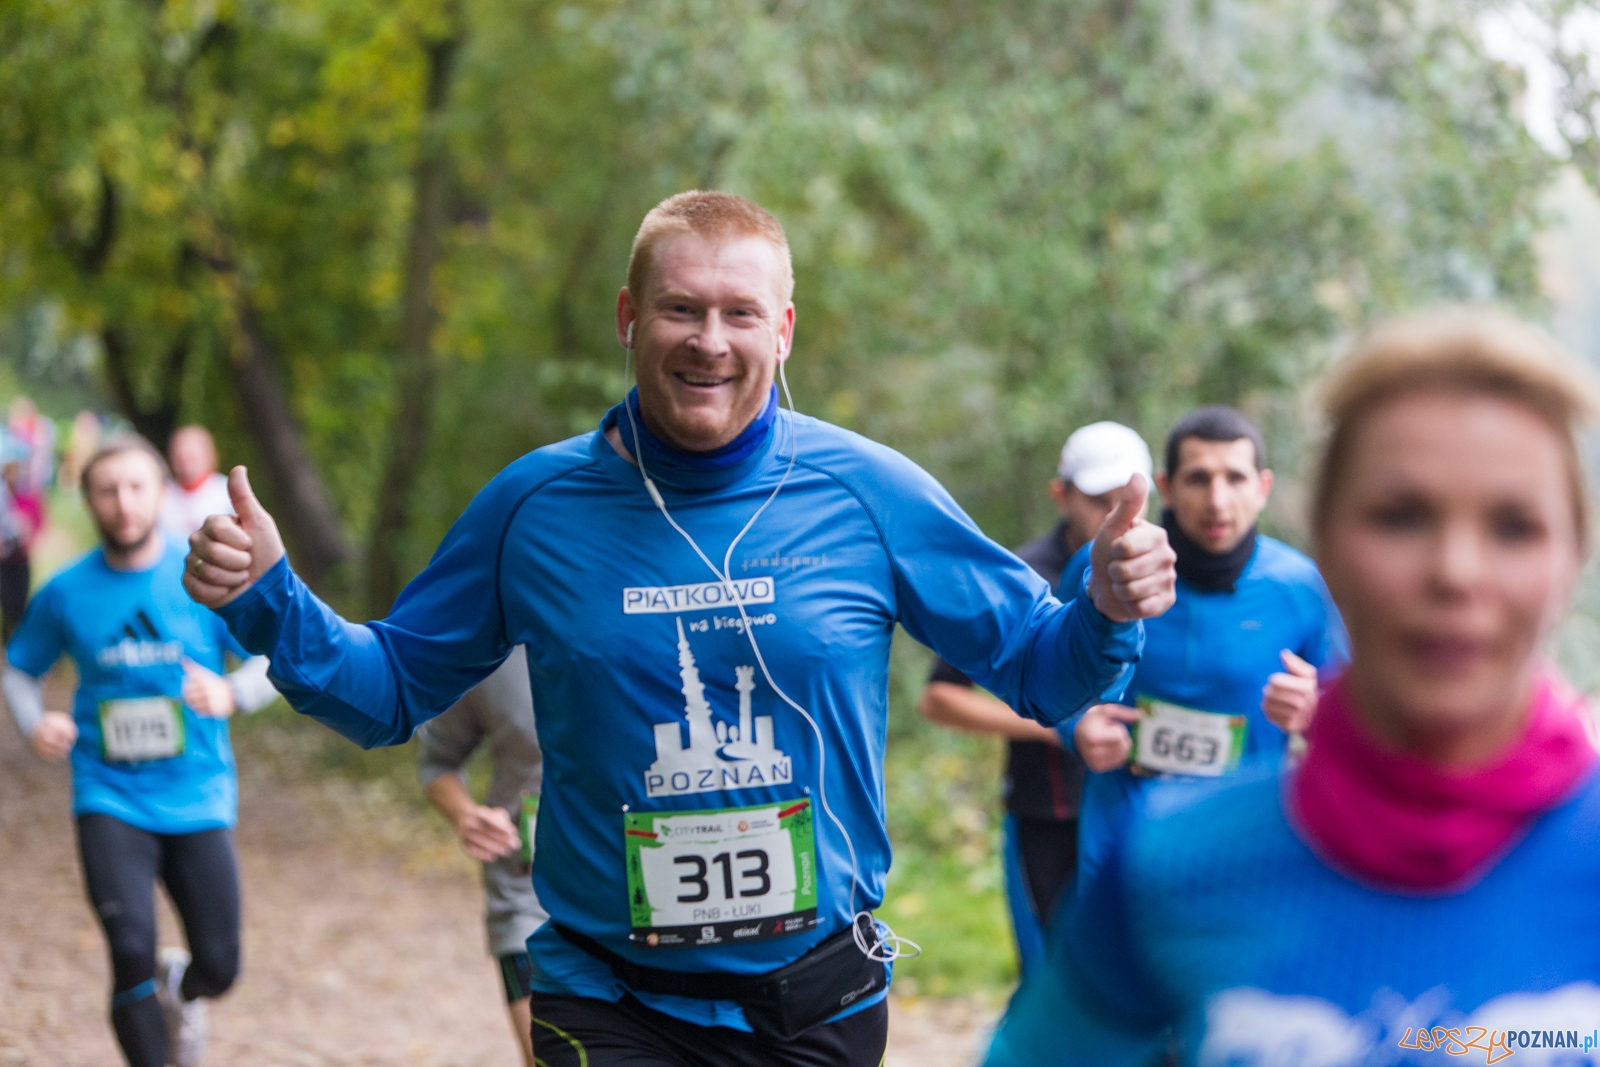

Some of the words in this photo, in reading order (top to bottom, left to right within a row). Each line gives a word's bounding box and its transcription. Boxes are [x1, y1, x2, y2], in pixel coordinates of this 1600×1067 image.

[626, 580, 771, 610] PIĄTKOWO
[688, 619, 709, 633] na
[713, 613, 777, 635] biegowo
[1151, 727, 1218, 765] 663
[648, 760, 790, 794] POZNAŃ
[673, 848, 772, 904] 313
[693, 906, 721, 921] PNB
[732, 903, 762, 919] ŁUKI
